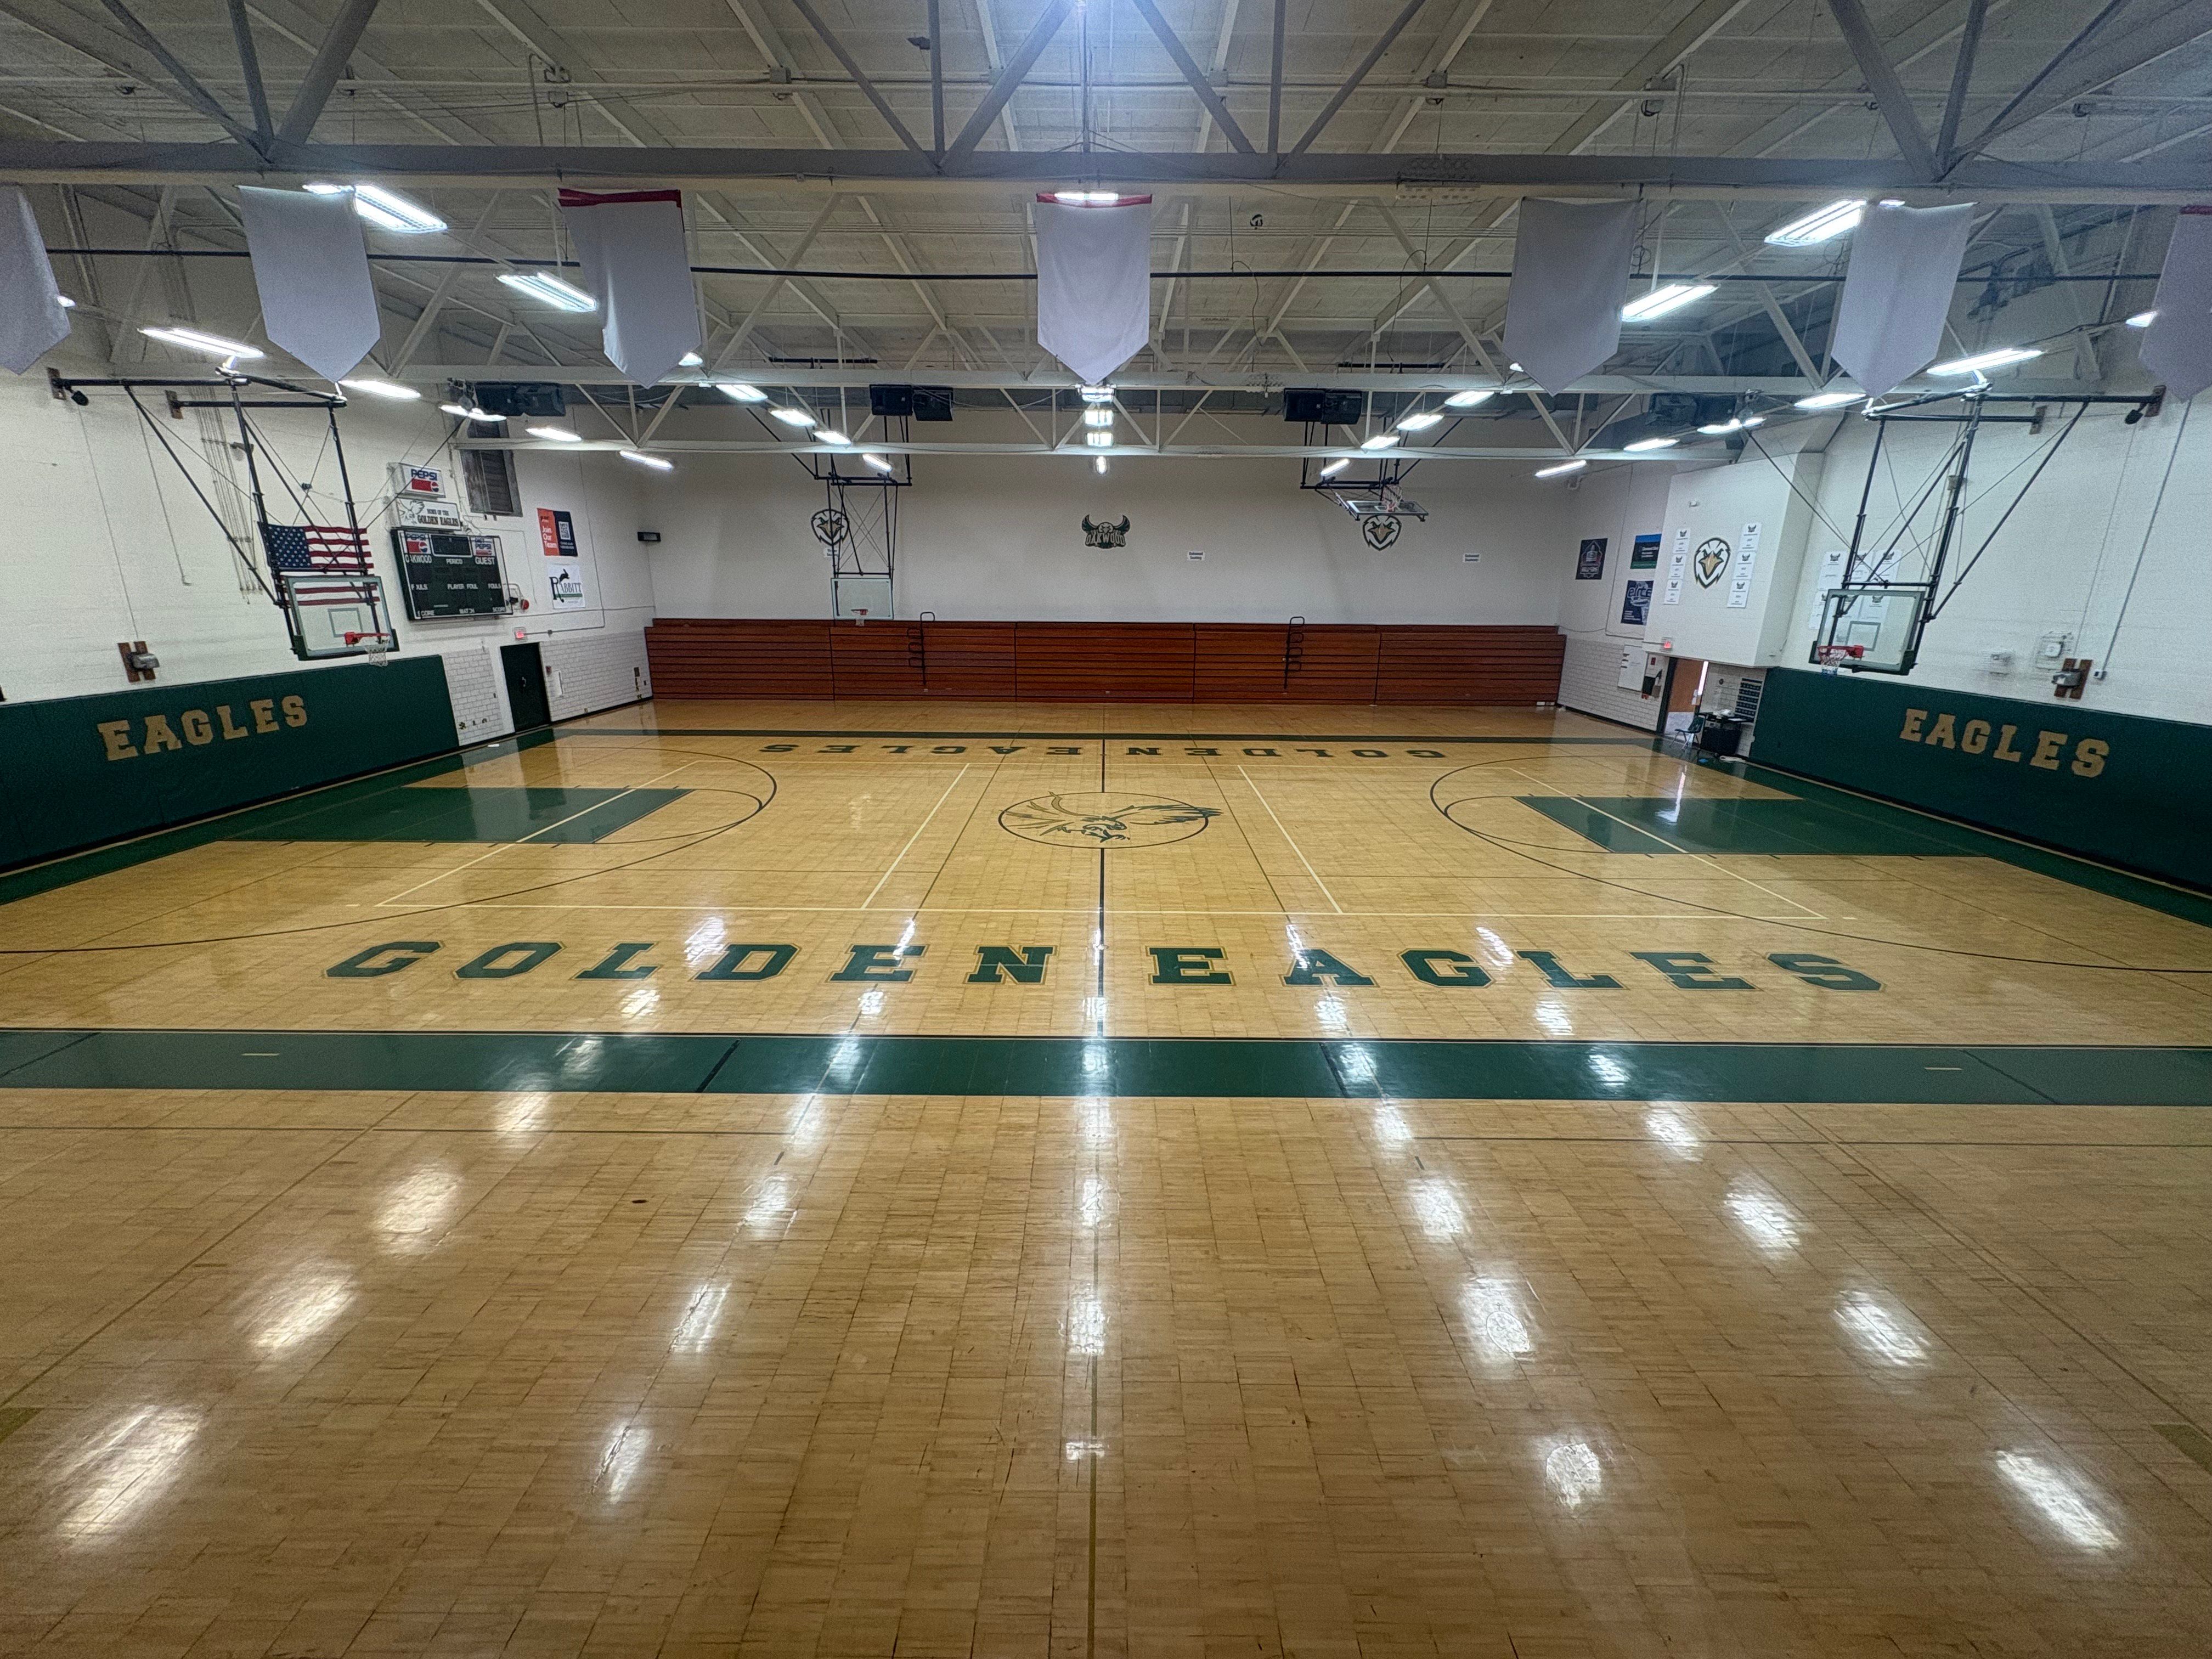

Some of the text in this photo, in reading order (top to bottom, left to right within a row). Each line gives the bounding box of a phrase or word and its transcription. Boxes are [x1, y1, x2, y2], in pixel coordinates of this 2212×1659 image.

[411, 469, 437, 481] PEPSI
[417, 515, 459, 527] GOLDEN EAGLES
[1086, 532, 1125, 545] OAKWOOD
[404, 554, 432, 563] OAKWOOD
[475, 556, 495, 565] GUEST
[97, 695, 308, 761] EAGLES
[1899, 708, 2110, 778] EAGLES
[758, 744, 1446, 758] GOLDEN EAGLES
[323, 940, 1887, 992] GOLDEN EAGLES
